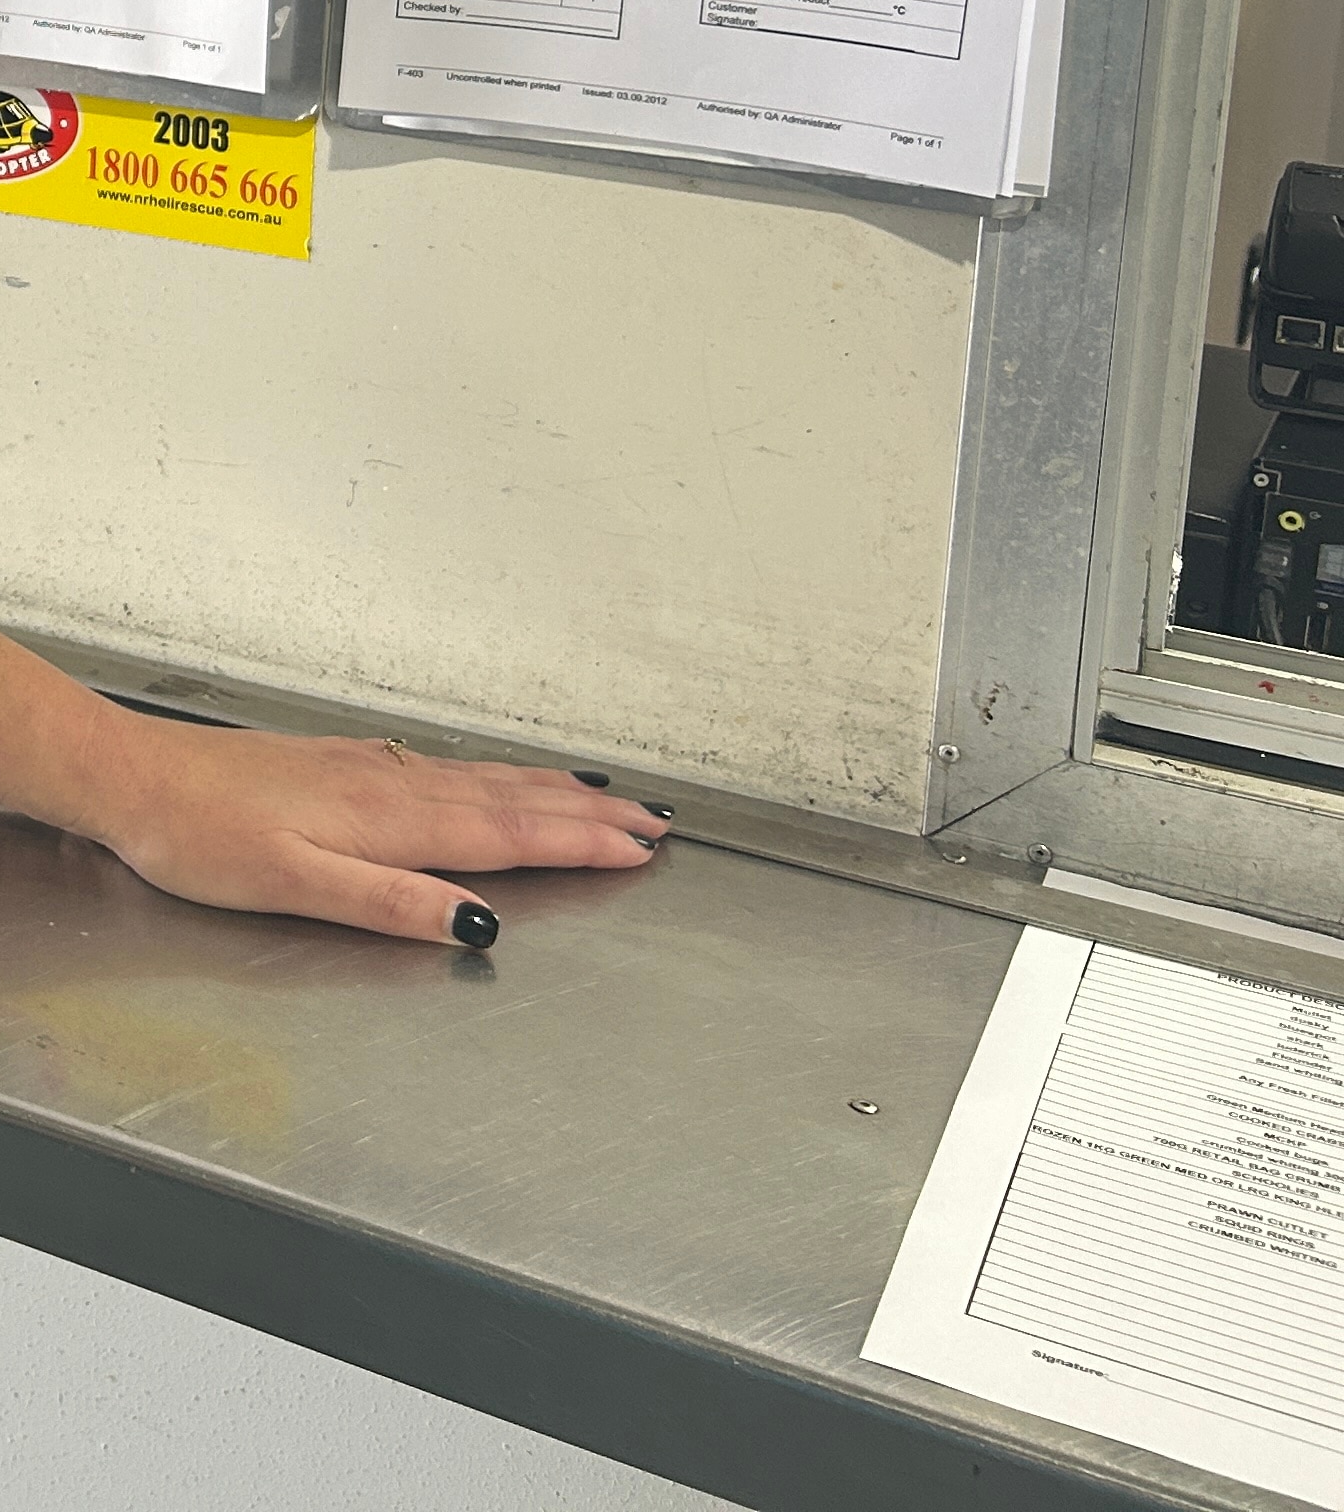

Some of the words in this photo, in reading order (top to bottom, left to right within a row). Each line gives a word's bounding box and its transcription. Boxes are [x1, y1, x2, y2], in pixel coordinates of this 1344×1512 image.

[403, 1, 447, 13] Checked
[708, 2, 758, 15] Customer
[707, 13, 758, 27] Signature:
[398, 68, 424, 78] F-403
[446, 72, 502, 86] Uncontrolled
[504, 79, 528, 88] when
[764, 110, 779, 122] QA
[781, 113, 842, 130] Administrator
[154, 111, 229, 152] 2003
[890, 132, 914, 146] Page
[925, 137, 934, 147] of
[86, 147, 158, 188] 1800
[171, 159, 228, 198] 665
[240, 168, 299, 209] 666
[1217, 973, 1299, 999] PRODUCT
[1228, 1111, 1292, 1133] COOKED
[1207, 1200, 1264, 1221] PRAWN
[1031, 1348, 1111, 1382] Signature:
